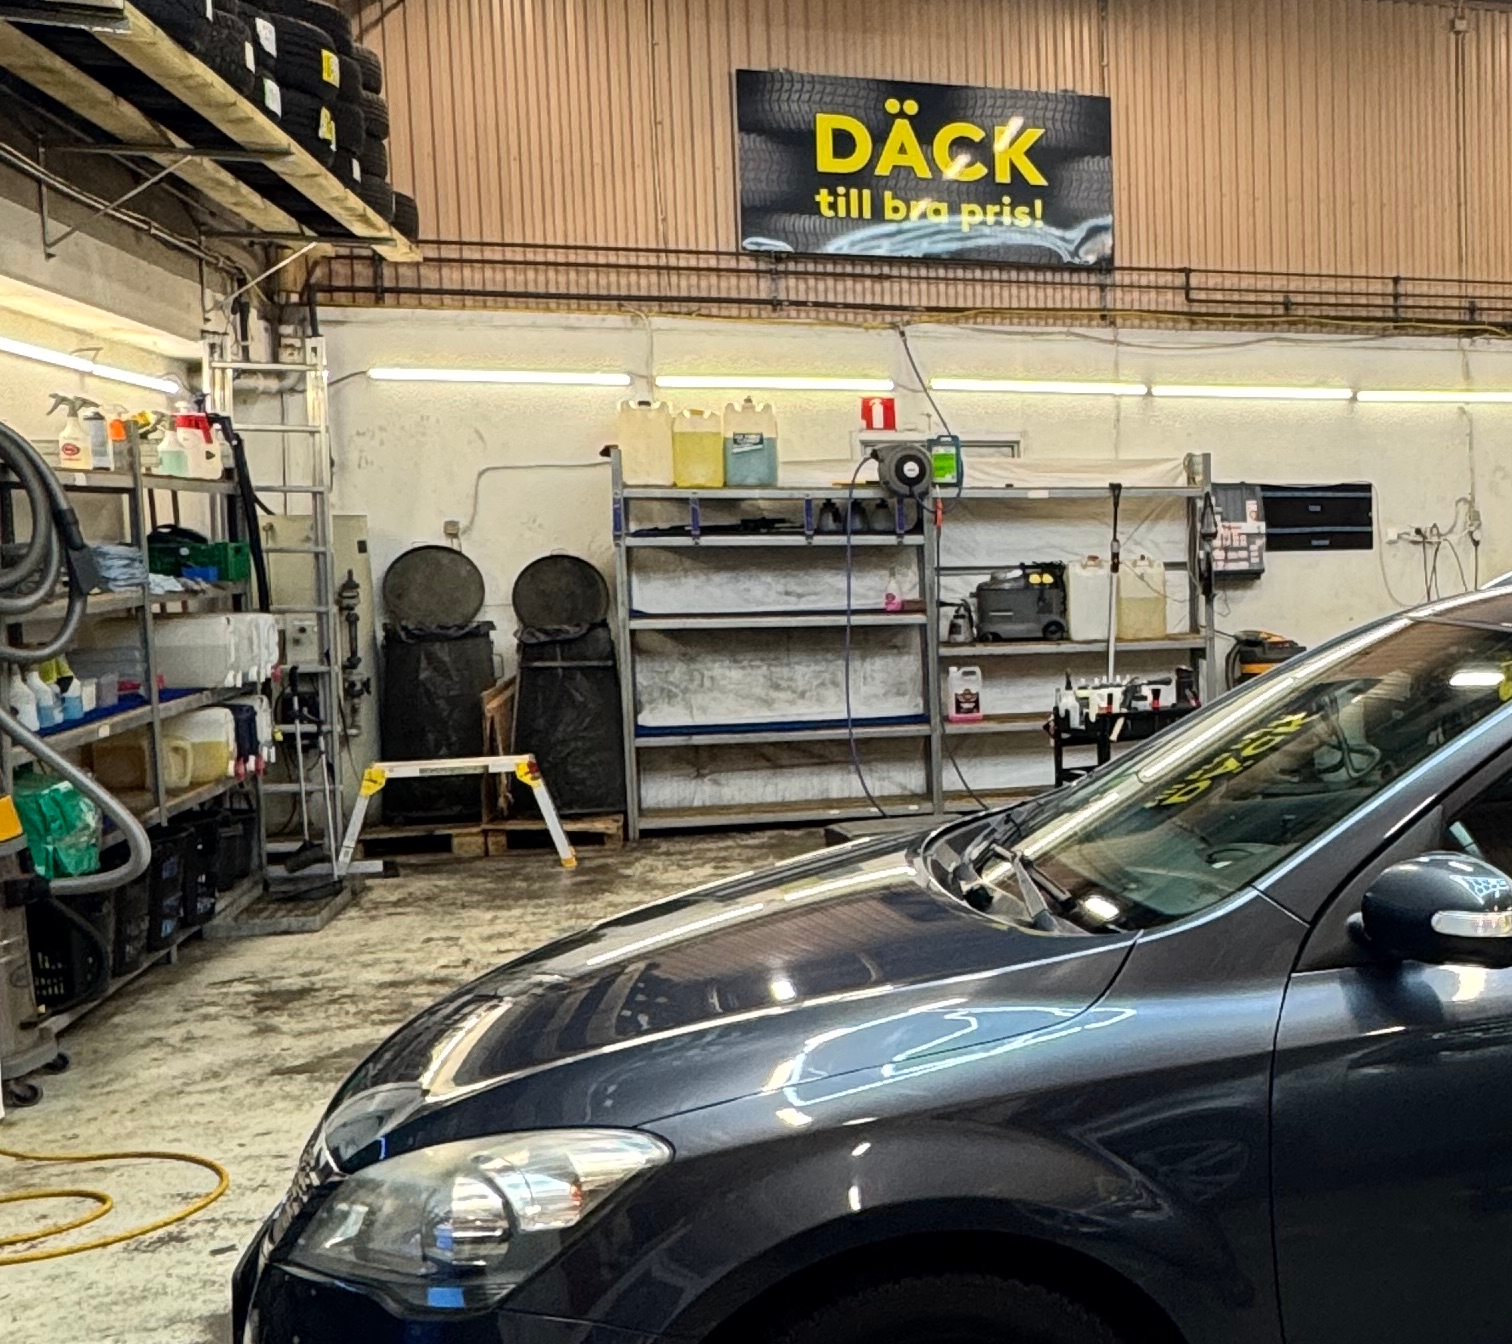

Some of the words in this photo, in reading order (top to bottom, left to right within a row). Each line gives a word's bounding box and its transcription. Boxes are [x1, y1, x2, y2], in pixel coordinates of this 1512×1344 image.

[814, 97, 1048, 187] DÄCK
[815, 187, 872, 220] till
[884, 191, 949, 222] bra
[960, 197, 1045, 231] pris!
